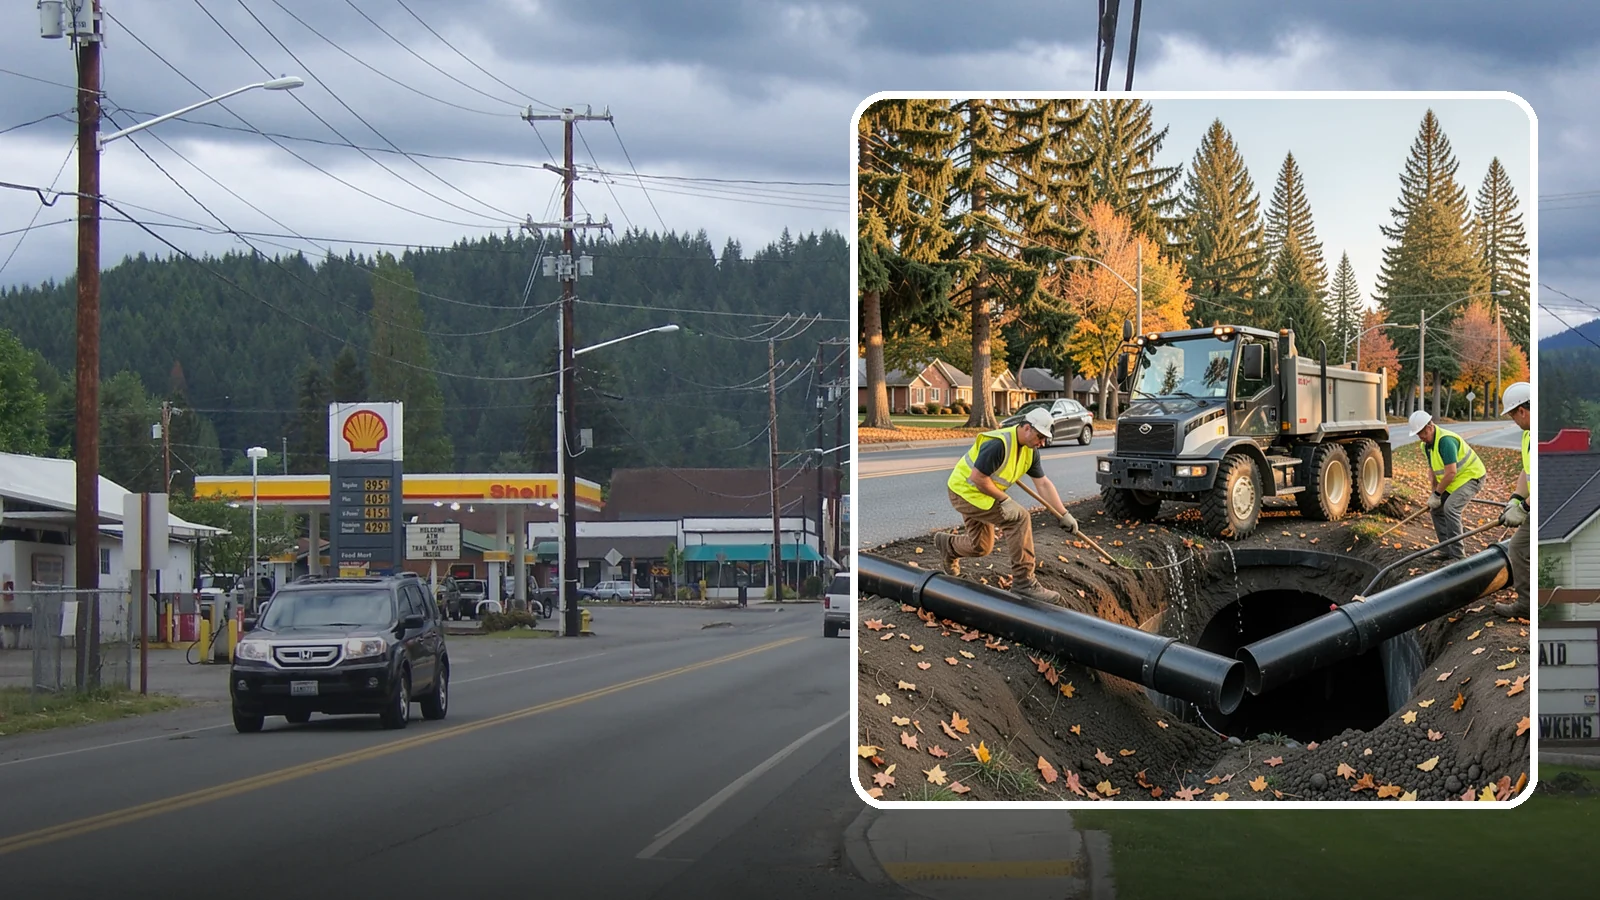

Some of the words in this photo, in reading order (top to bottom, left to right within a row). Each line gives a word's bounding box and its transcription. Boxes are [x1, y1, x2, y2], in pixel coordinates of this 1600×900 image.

[366, 480, 383, 490] 395
[490, 484, 547, 499] Shell
[366, 494, 383, 504] 405
[366, 508, 383, 518] 415
[366, 522, 383, 532] 429
[1538, 643, 1566, 665] AID
[1538, 716, 1592, 739] WKENS
